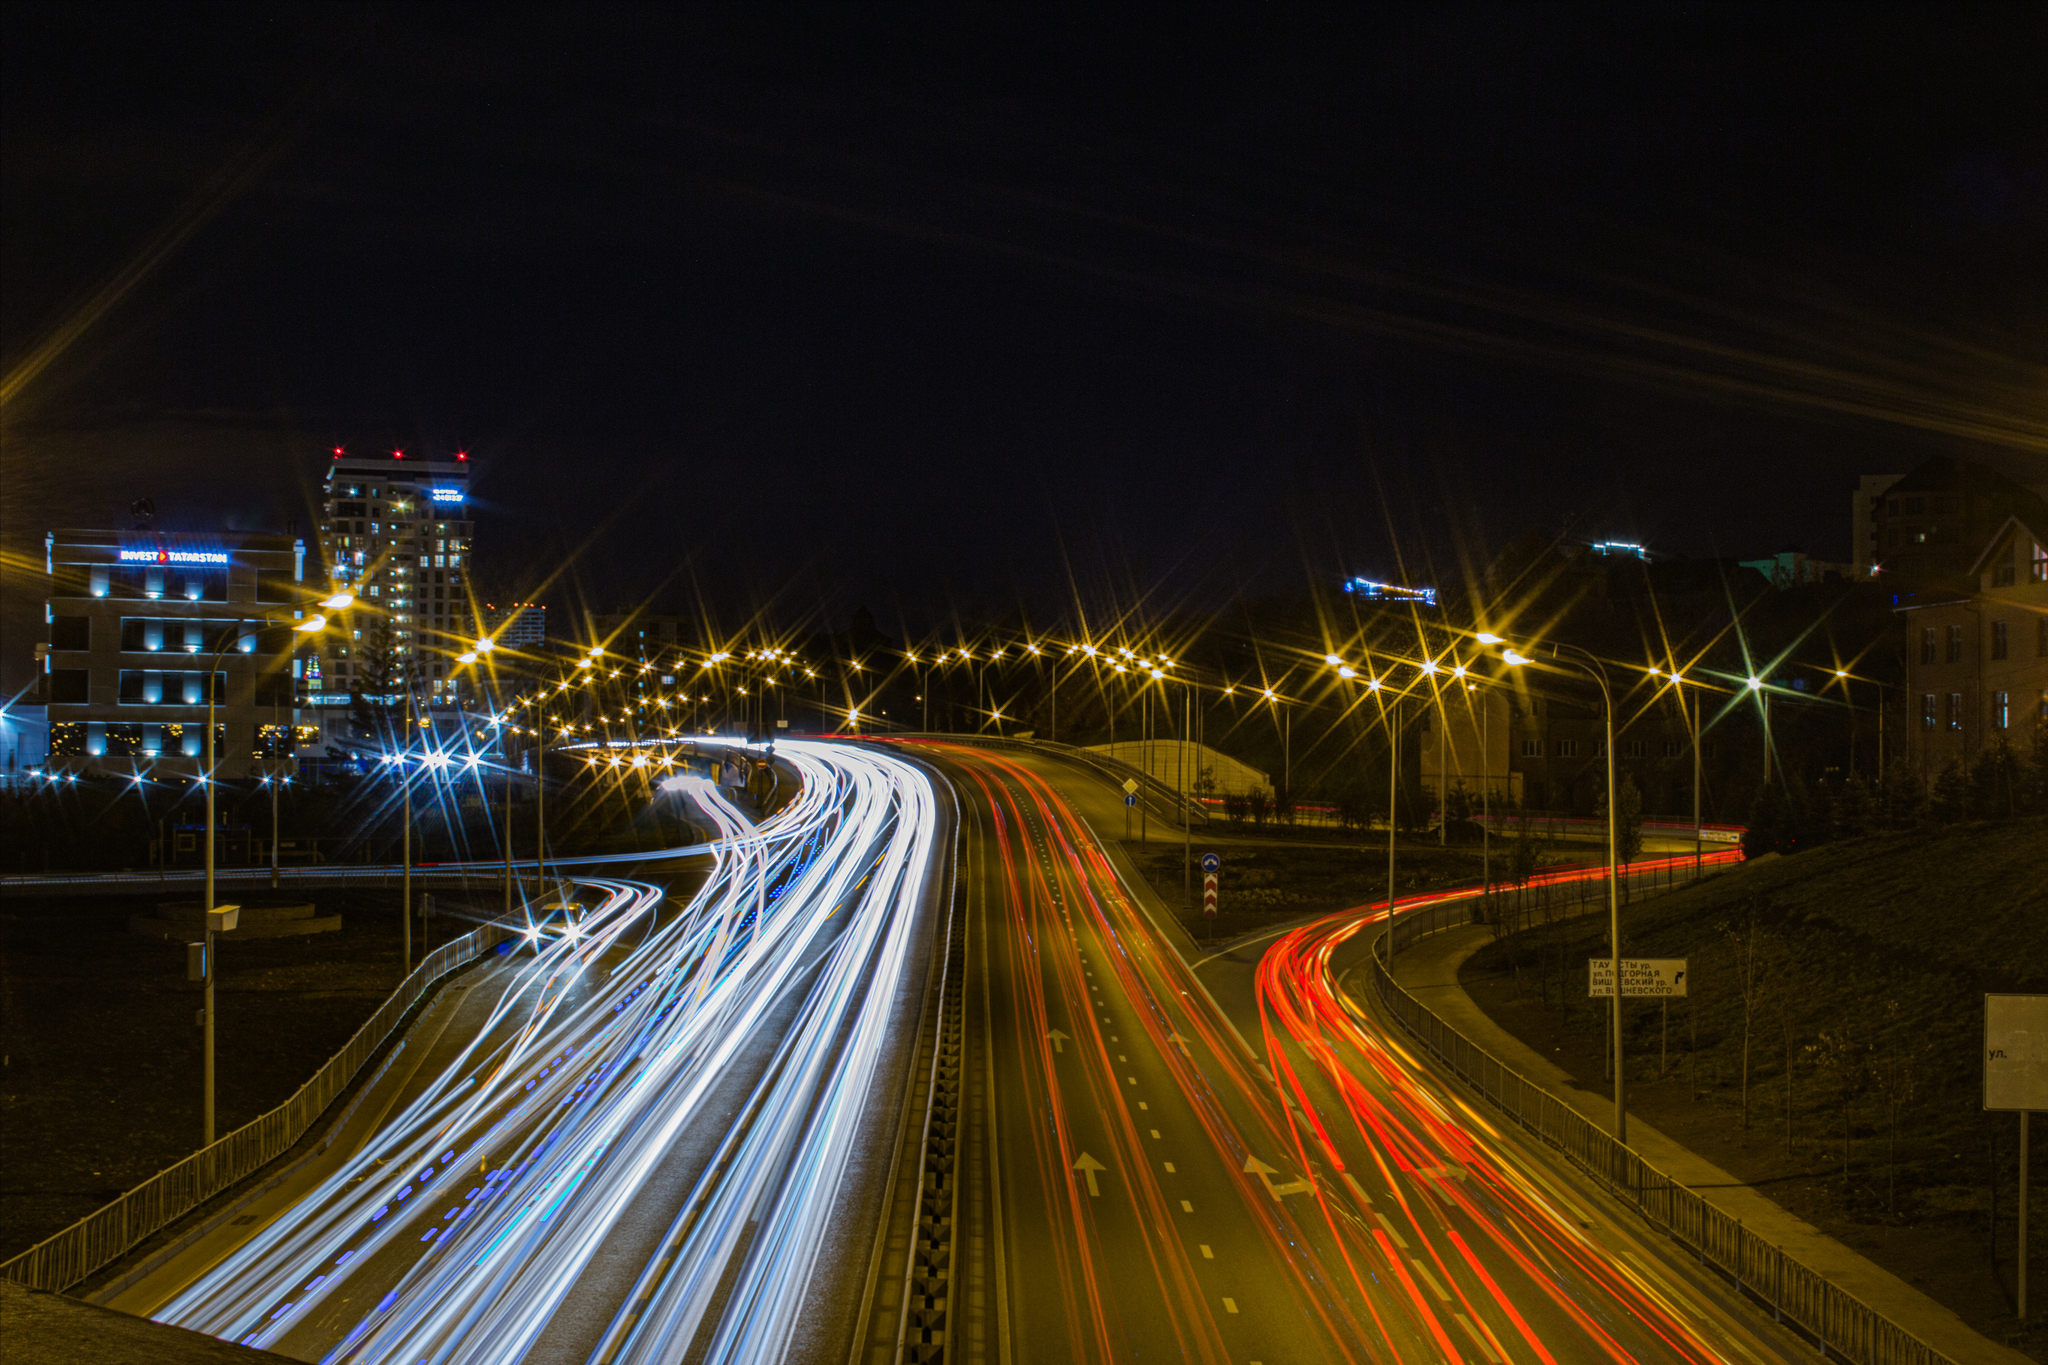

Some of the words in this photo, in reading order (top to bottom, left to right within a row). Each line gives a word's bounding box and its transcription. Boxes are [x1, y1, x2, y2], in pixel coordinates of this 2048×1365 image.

[121, 551, 158, 560] INVEST
[168, 552, 227, 563] TATARSTAN
[1592, 961, 1610, 969] ТАУ
[1619, 961, 1638, 969] СТЫ
[1592, 978, 1654, 986] ВИШЕВСКИЙ
[1593, 988, 1604, 996] ул.
[1989, 1050, 2007, 1061] ул.
